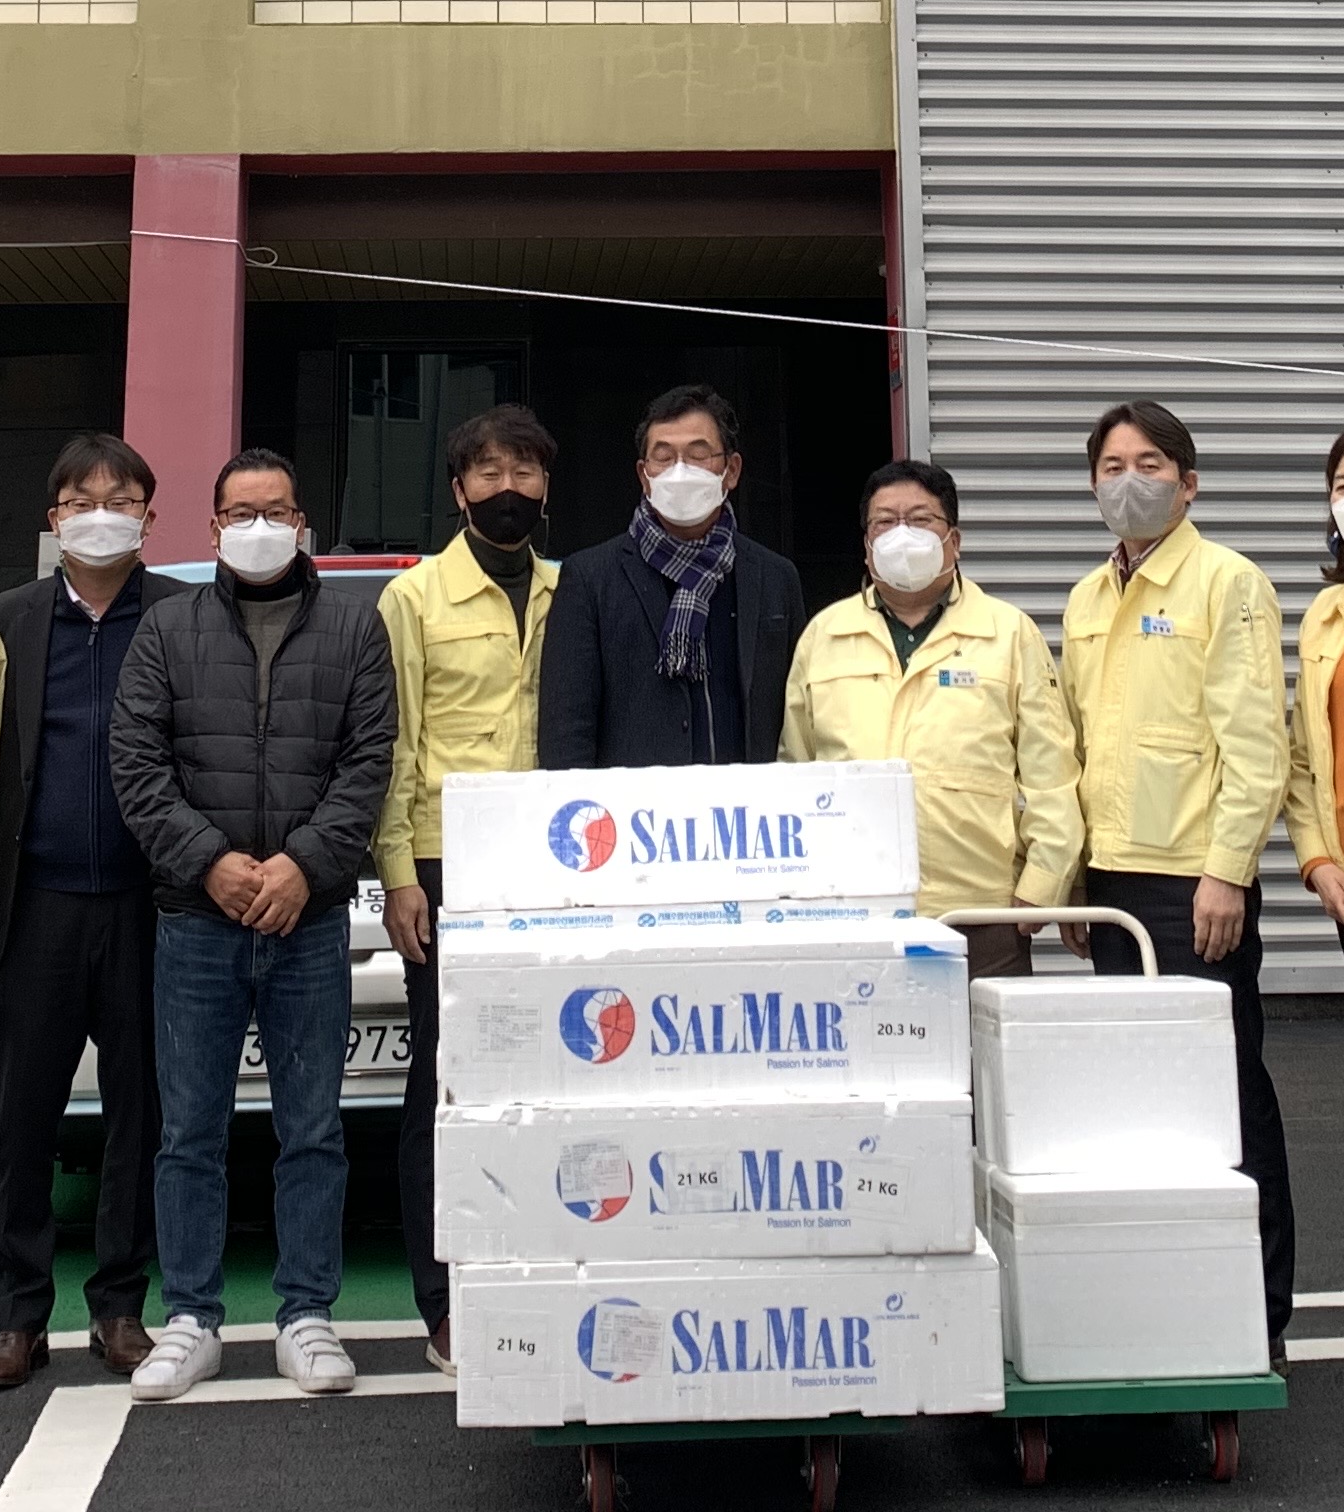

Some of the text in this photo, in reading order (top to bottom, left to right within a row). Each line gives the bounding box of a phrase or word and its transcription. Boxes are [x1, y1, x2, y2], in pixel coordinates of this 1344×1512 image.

[736, 864, 810, 875] Passion for Salmon
[877, 1023, 927, 1040] 20.3 kg
[345, 1025, 413, 1063] 973
[767, 1057, 850, 1070] Passion for Salmon
[677, 1171, 719, 1186] 21 KG
[857, 1178, 898, 1196] 21 KG
[767, 1217, 851, 1228] Passion for Salmon
[497, 1338, 536, 1356] 21 kg
[792, 1374, 877, 1388] Passion for Salmon
